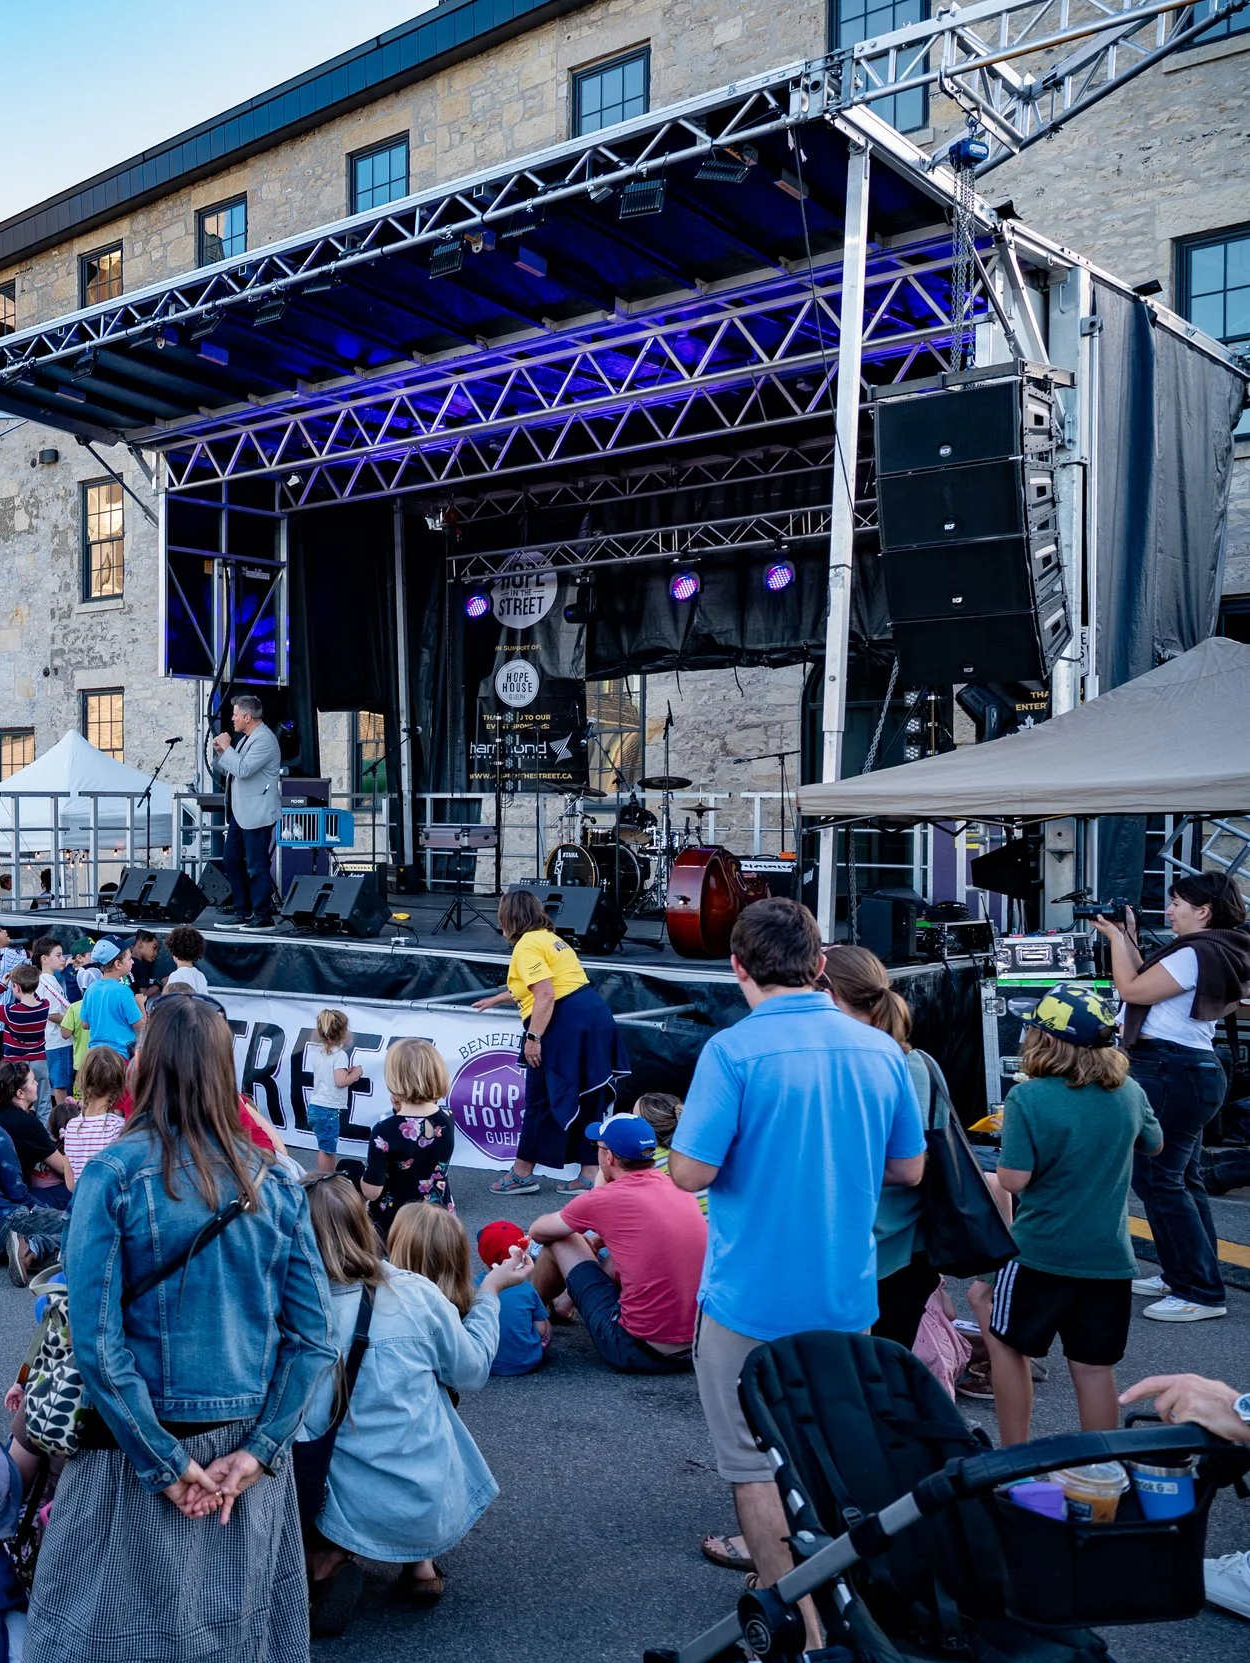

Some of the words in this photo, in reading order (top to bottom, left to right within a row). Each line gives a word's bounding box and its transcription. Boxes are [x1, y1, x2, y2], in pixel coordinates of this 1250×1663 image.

[499, 596, 544, 616] STREET
[507, 672, 529, 682] HOPE
[502, 683, 532, 692] HOUSE
[1031, 690, 1049, 699] THA
[1016, 702, 1047, 711] ENTER
[470, 741, 546, 753] hamond
[458, 1033, 524, 1060] BENEFIT
[472, 1081, 519, 1108] HOP
[463, 1105, 525, 1128] HOU
[485, 1131, 522, 1146] GUEL
